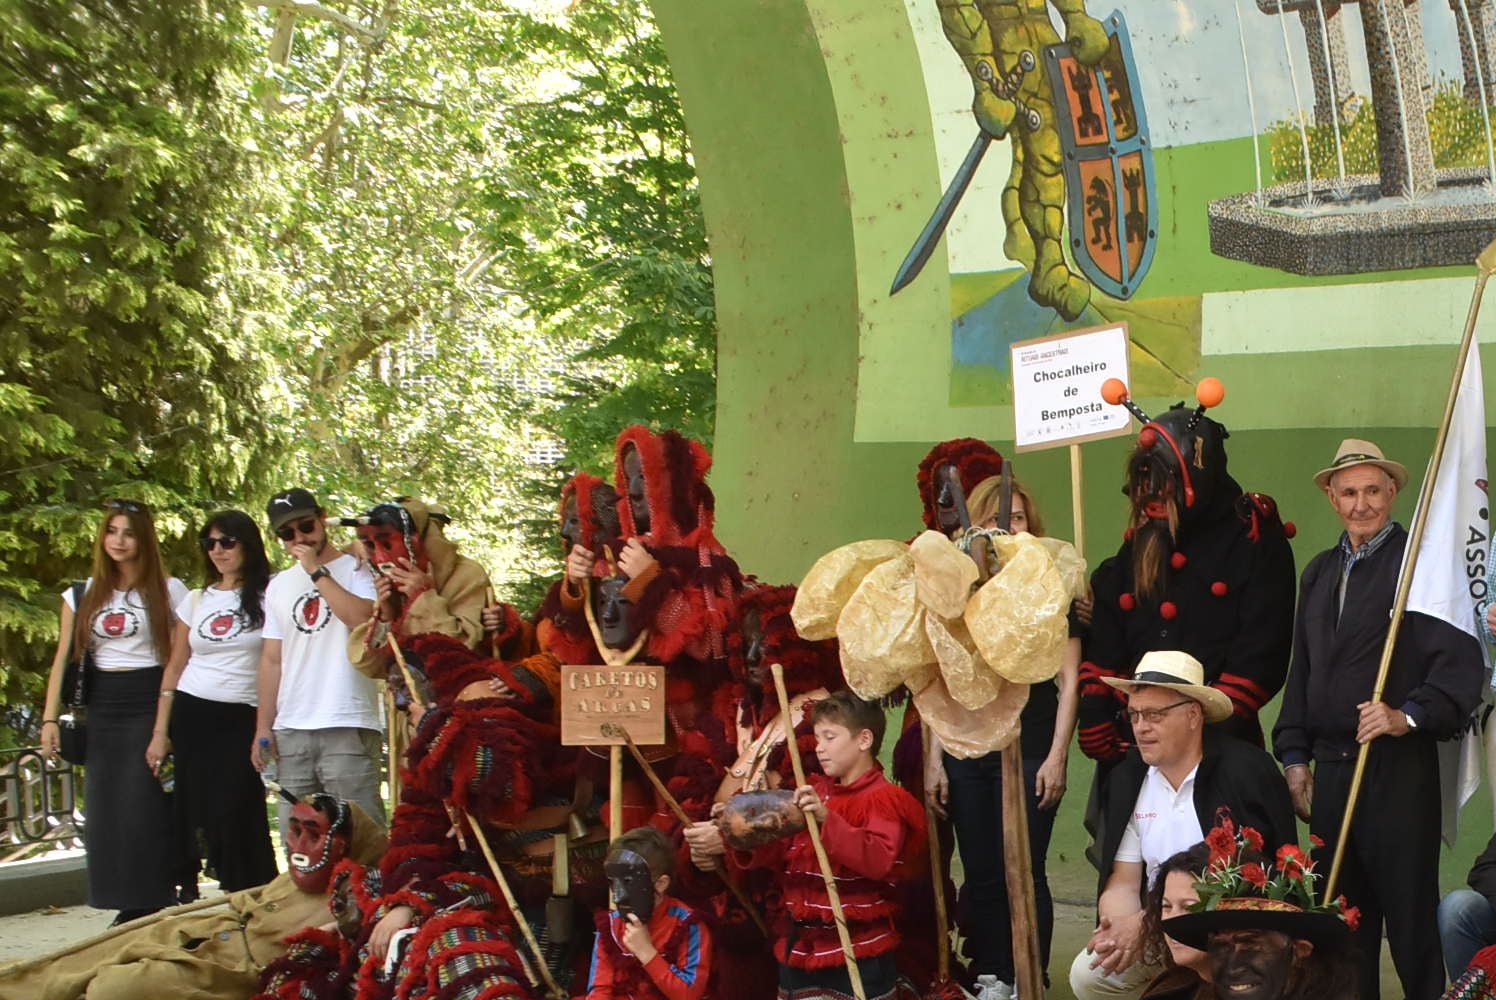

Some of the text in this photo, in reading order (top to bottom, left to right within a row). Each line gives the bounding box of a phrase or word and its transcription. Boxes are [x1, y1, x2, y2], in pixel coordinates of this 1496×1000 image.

[1033, 361, 1107, 383] Chocalheiro
[1063, 386, 1079, 397] de
[1041, 402, 1103, 421] Bemposta
